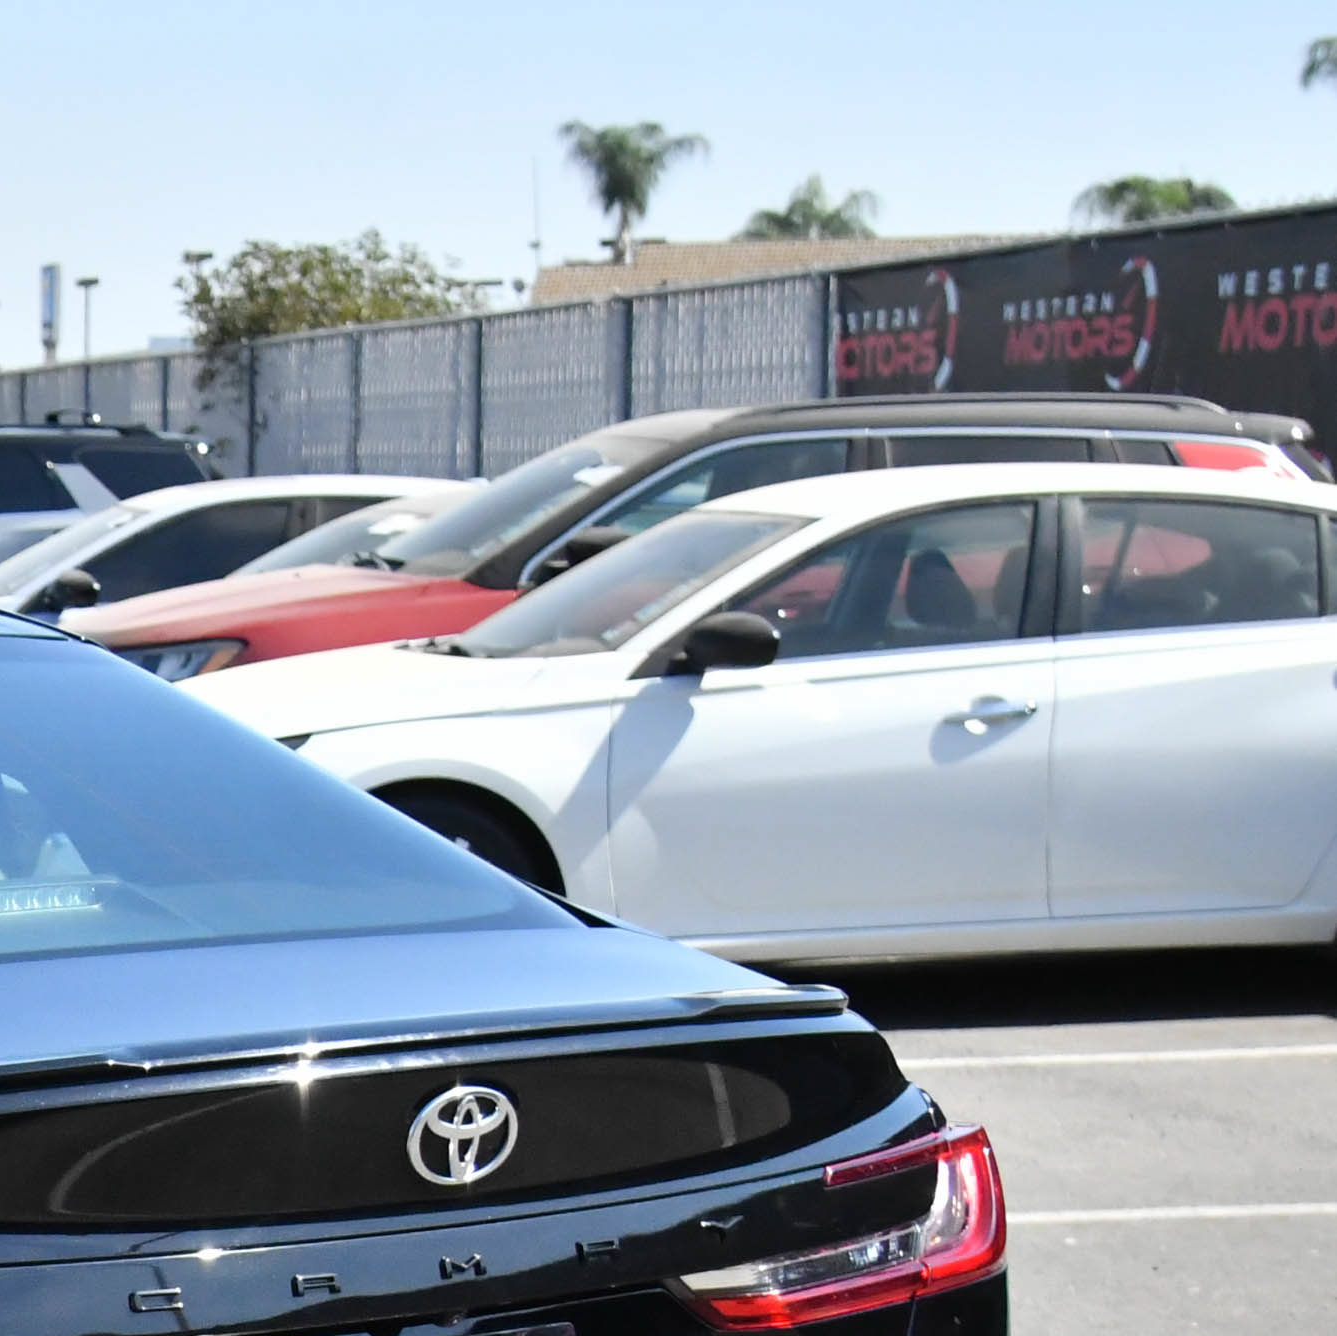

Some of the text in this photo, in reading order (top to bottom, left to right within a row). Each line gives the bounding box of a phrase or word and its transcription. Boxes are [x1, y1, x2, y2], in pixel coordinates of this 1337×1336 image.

[1217, 261, 1330, 298] WESTE
[836, 305, 920, 335] STERN
[1002, 292, 1115, 322] WESTERN
[1216, 292, 1337, 353] MOTO
[836, 328, 939, 379] OTORS
[1004, 314, 1135, 366] MOTORS
[128, 1215, 743, 1314] CAMRY
